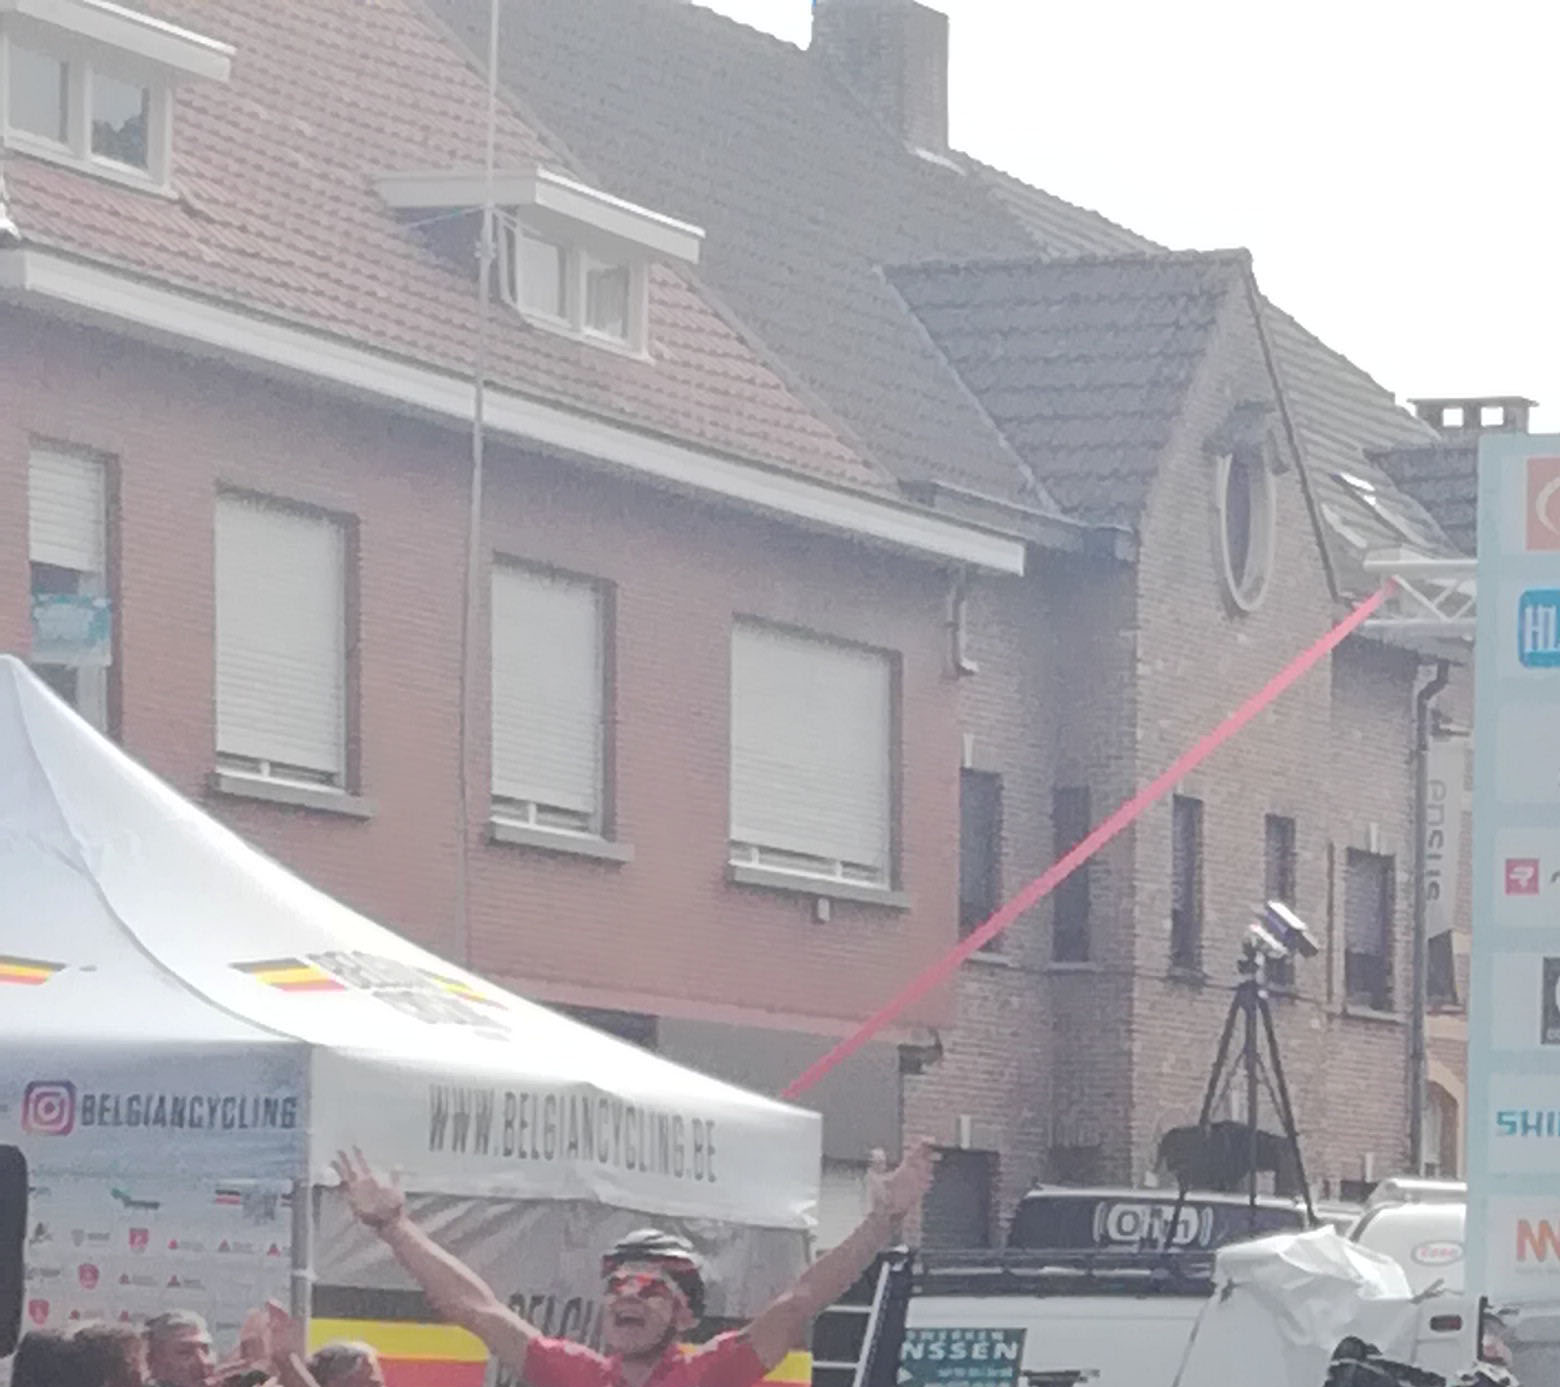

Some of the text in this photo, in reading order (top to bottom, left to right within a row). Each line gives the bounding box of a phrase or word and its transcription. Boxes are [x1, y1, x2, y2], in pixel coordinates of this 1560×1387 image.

[81, 1094, 298, 1129] BELGIANCYCLING
[428, 1083, 718, 1184] WWW.BELGIANCYCLING.BE
[900, 1341, 1018, 1361] NSSEN
